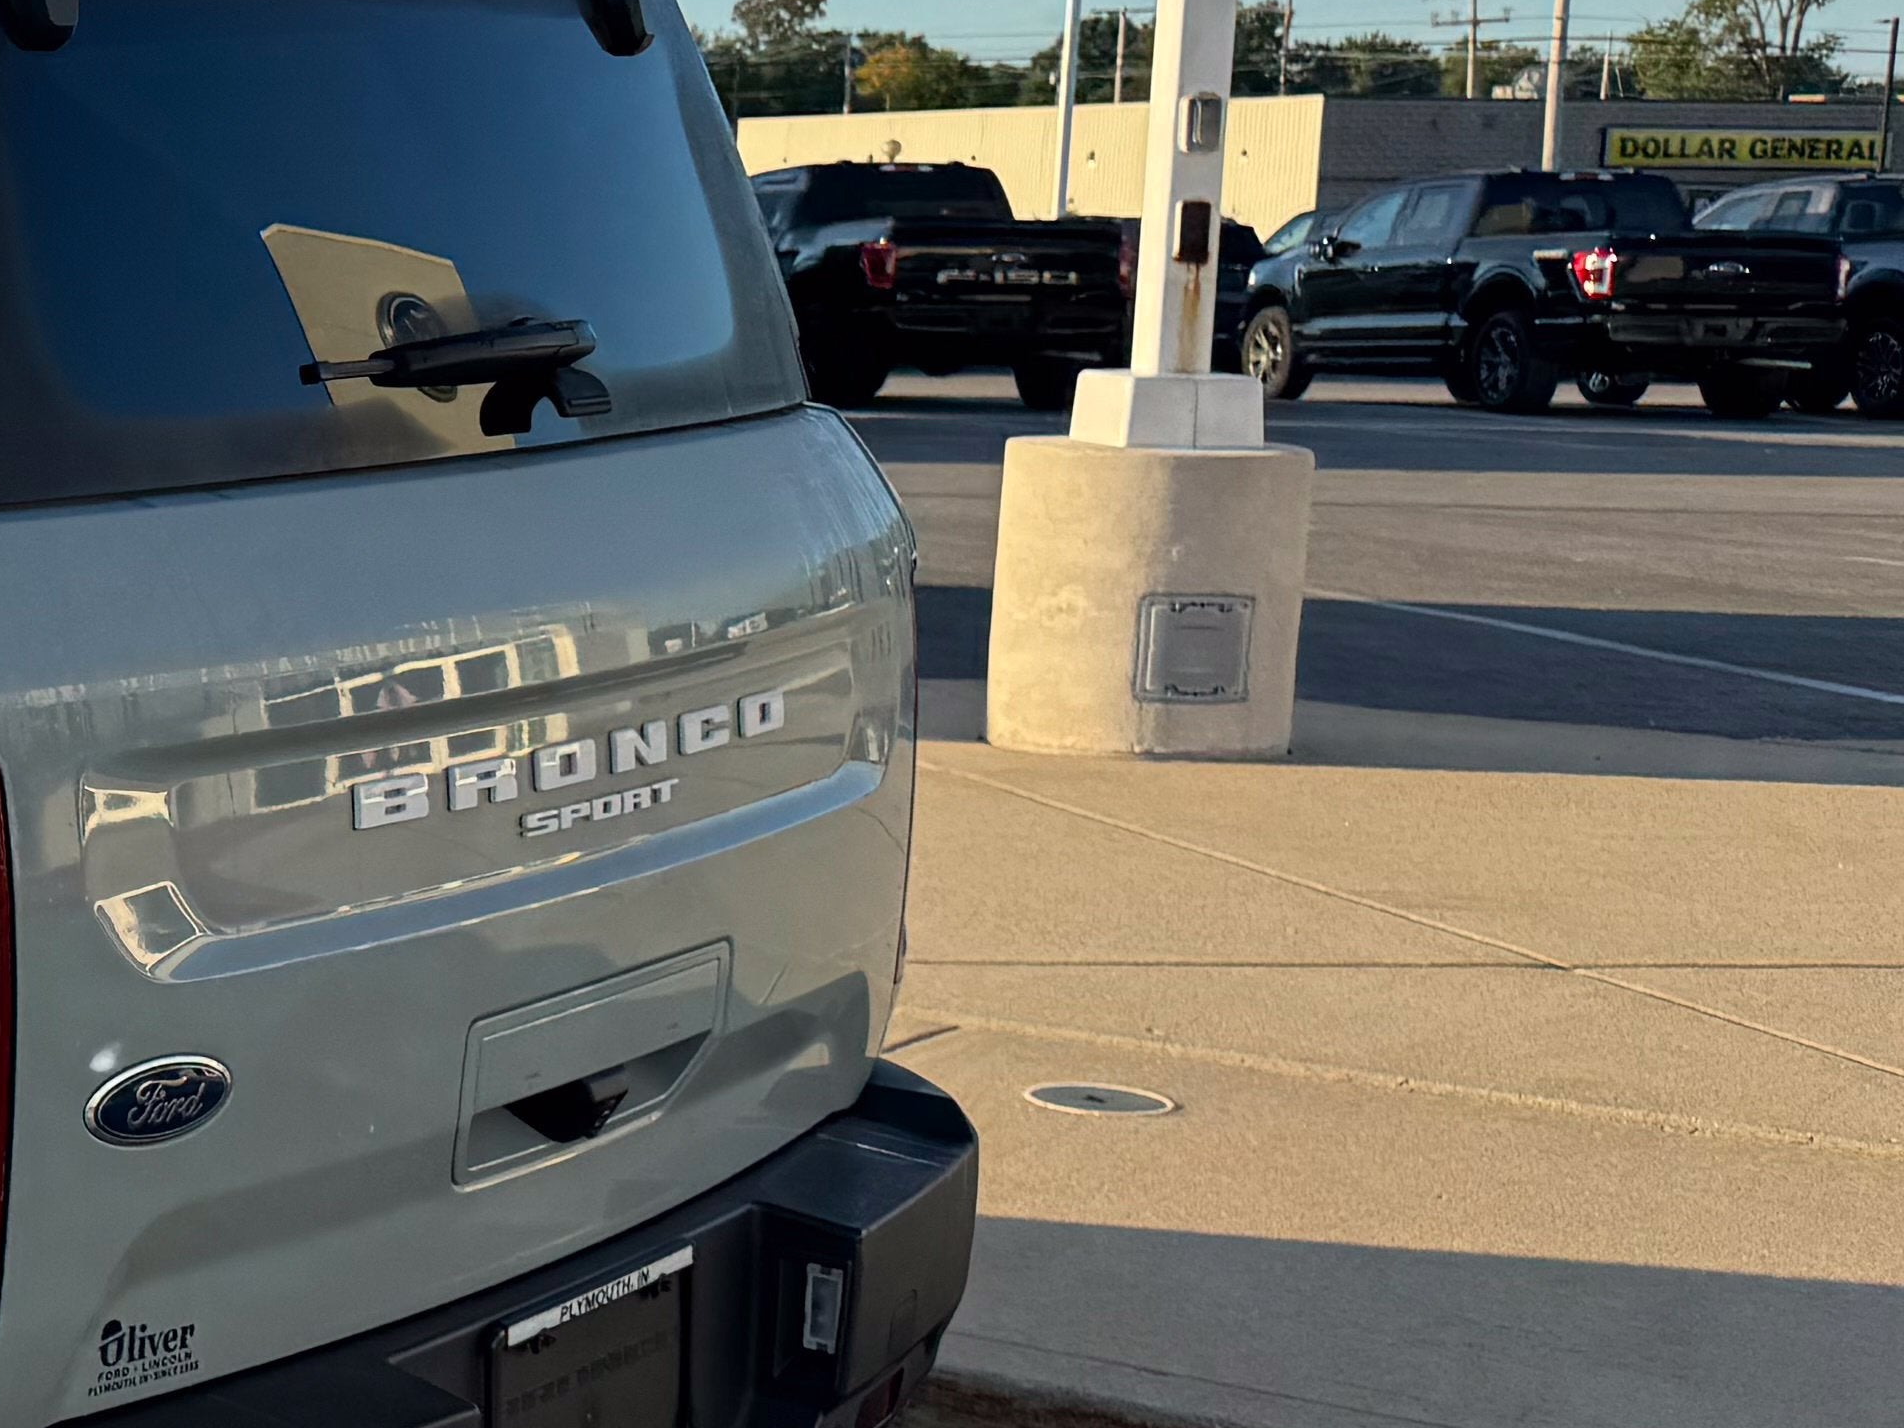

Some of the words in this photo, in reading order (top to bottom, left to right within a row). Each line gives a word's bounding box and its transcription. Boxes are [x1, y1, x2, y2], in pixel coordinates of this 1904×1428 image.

[1619, 136, 1737, 160] DOLLAR
[1749, 136, 1880, 161] GENERAL
[352, 689, 786, 831] BRONCO
[522, 777, 680, 838] SPORT
[127, 1075, 207, 1127] Ford
[97, 1366, 130, 1383] FORD
[142, 1351, 193, 1372] LINCOLN
[98, 1319, 196, 1367] Oliver
